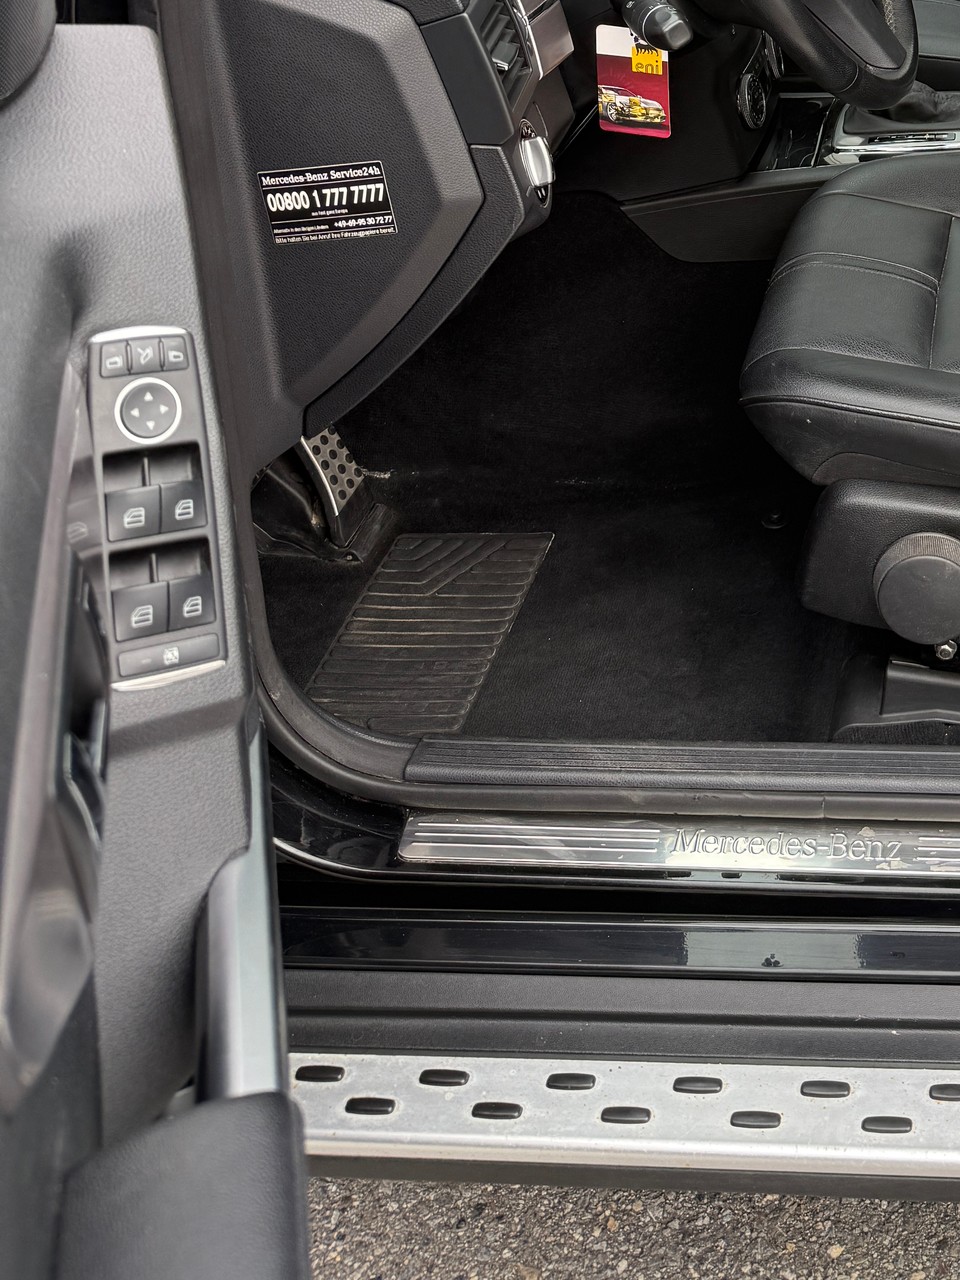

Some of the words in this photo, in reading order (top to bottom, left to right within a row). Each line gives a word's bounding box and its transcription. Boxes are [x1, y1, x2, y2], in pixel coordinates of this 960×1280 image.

[261, 172, 329, 186] Mercedes-Benz
[329, 165, 381, 180] Service24h
[266, 190, 310, 212] 00800
[312, 189, 321, 208] 1
[321, 186, 348, 207] 777
[349, 182, 384, 204] 7777
[669, 827, 903, 862] Mercedes-Benz
